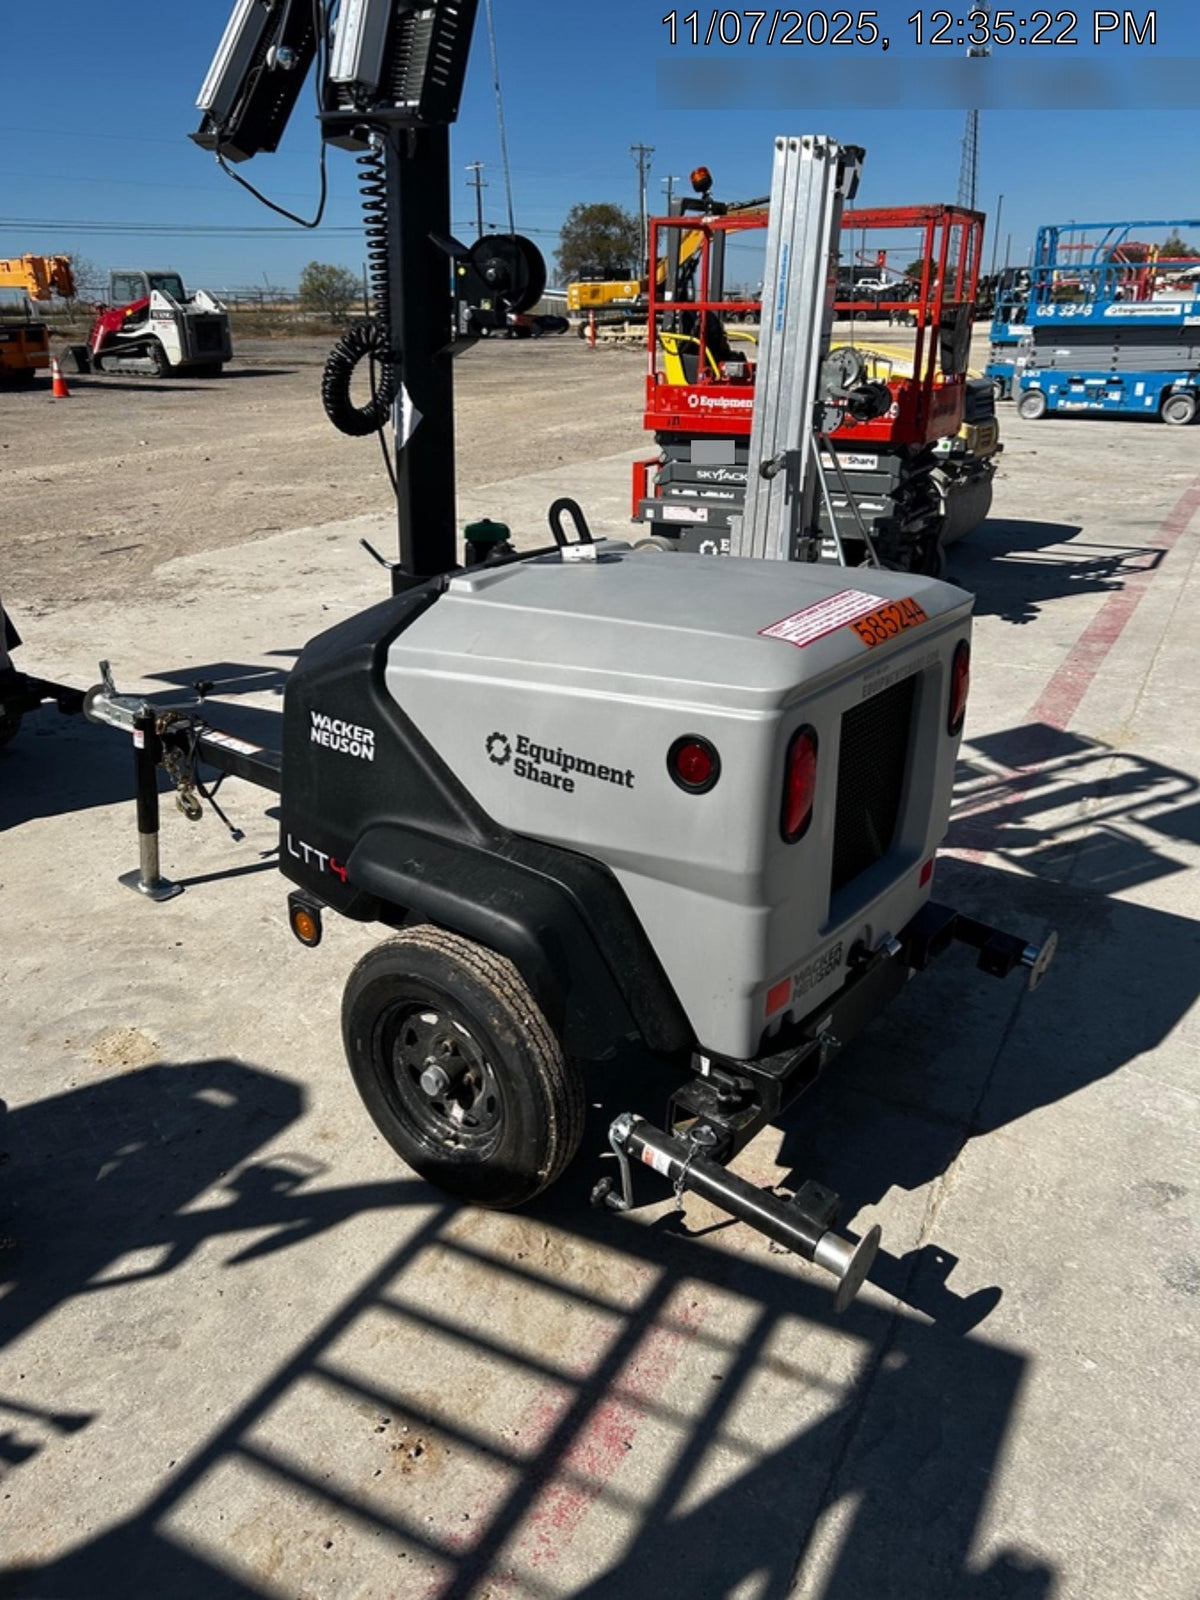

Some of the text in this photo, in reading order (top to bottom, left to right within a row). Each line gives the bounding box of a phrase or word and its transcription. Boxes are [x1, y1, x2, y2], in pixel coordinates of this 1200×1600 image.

[700, 396, 754, 409] Equipmen
[853, 598, 925, 646] 585244
[310, 711, 375, 746] WACKER
[310, 726, 375, 762] NEUSON
[513, 757, 576, 793] Share
[515, 734, 635, 789] Equipment
[286, 833, 348, 883] LTT4
